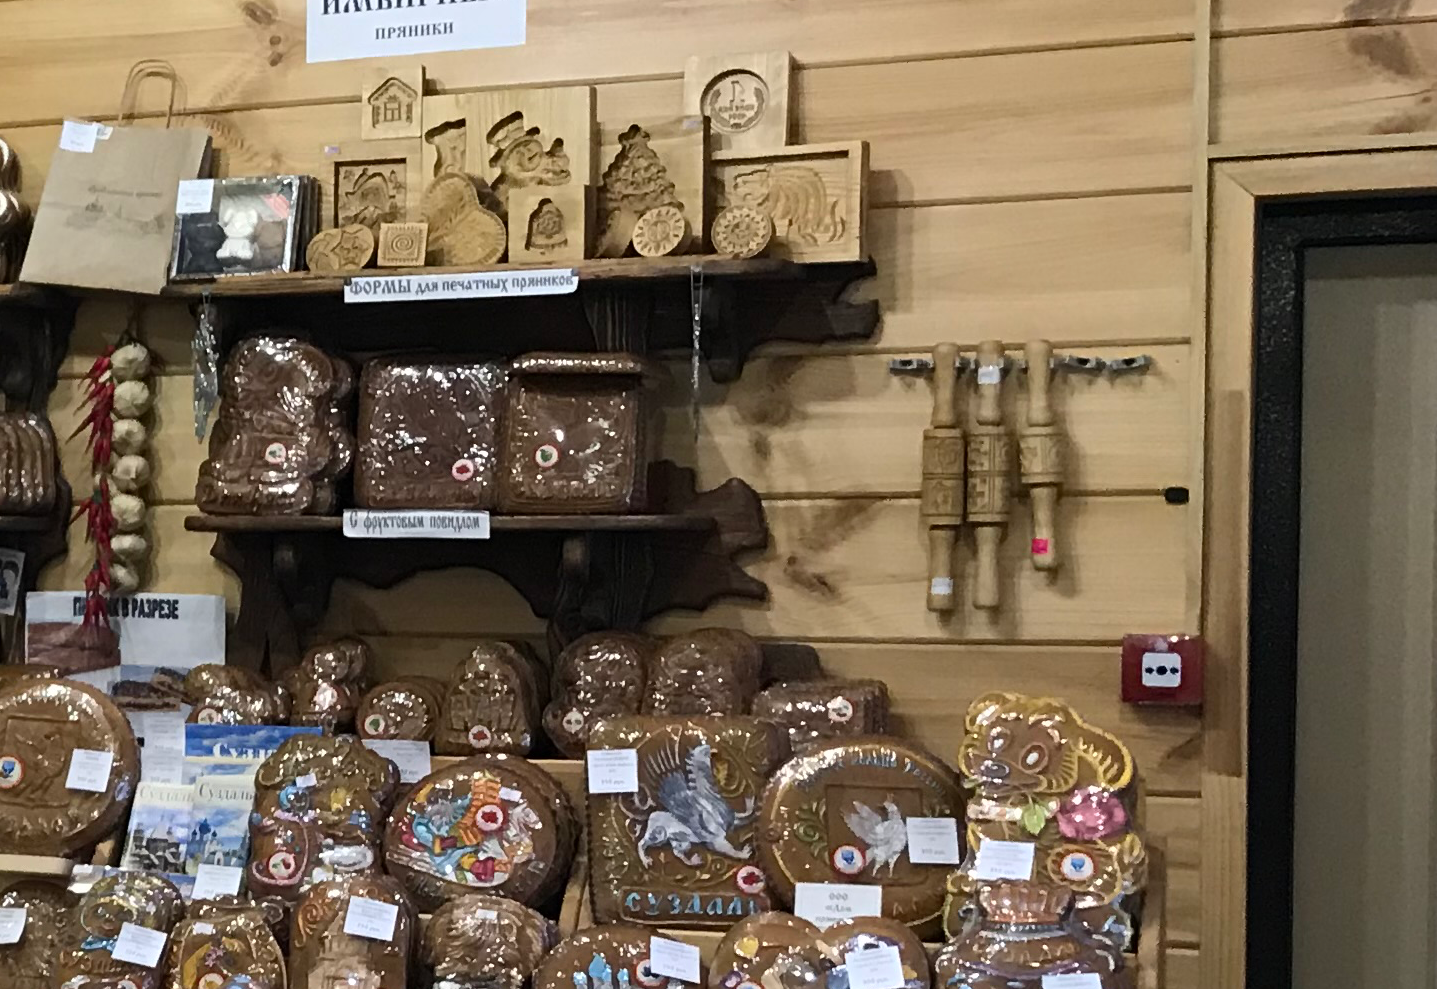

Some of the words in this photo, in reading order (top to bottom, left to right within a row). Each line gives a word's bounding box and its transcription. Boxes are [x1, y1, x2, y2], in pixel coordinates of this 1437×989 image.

[375, 22, 454, 40] ПРЯНИКИ
[350, 278, 412, 295] ФОРМЫ
[415, 280, 439, 296] для
[442, 278, 509, 293] печатных
[512, 275, 574, 289] пряников
[349, 510, 358, 528] С
[364, 510, 425, 535] фруктовым
[430, 515, 480, 533] повидлом
[121, 597, 129, 619] В
[131, 598, 180, 620] РАЗРЕЗЕ
[199, 782, 253, 802] Суздаль
